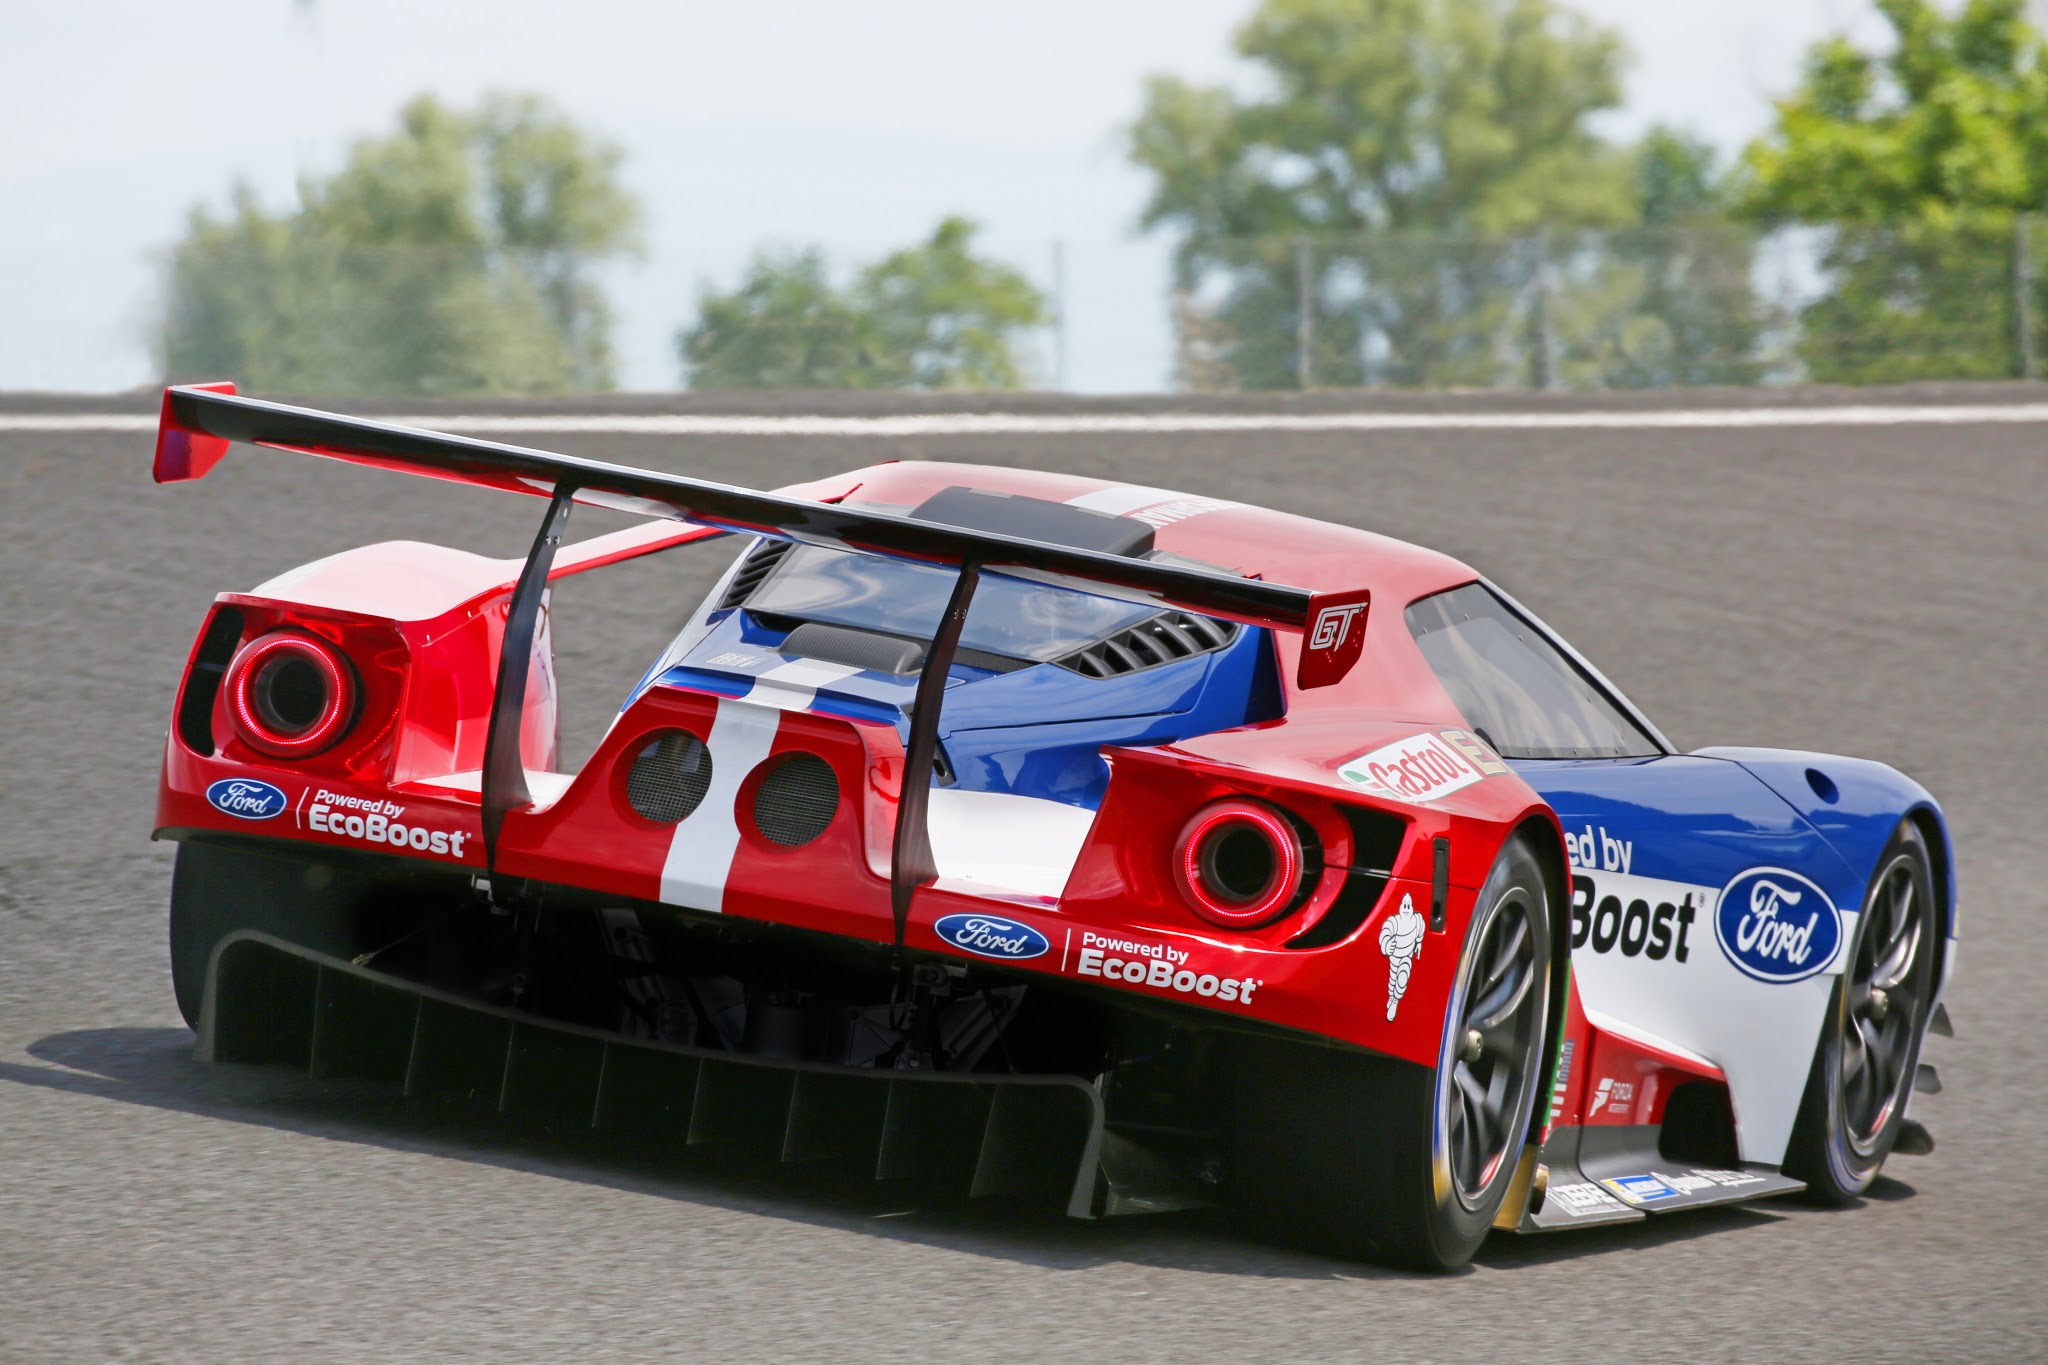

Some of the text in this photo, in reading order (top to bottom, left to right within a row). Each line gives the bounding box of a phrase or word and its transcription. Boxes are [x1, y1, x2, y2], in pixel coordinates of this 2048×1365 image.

[1310, 602, 1369, 652] GT
[1367, 740, 1470, 797] Castrol
[219, 781, 273, 816] Ford
[314, 789, 406, 819] Powered by
[1600, 825, 1633, 875] by
[955, 917, 1030, 955] Ford
[1737, 879, 1820, 966] Ford
[1081, 932, 1190, 966] Powered by
